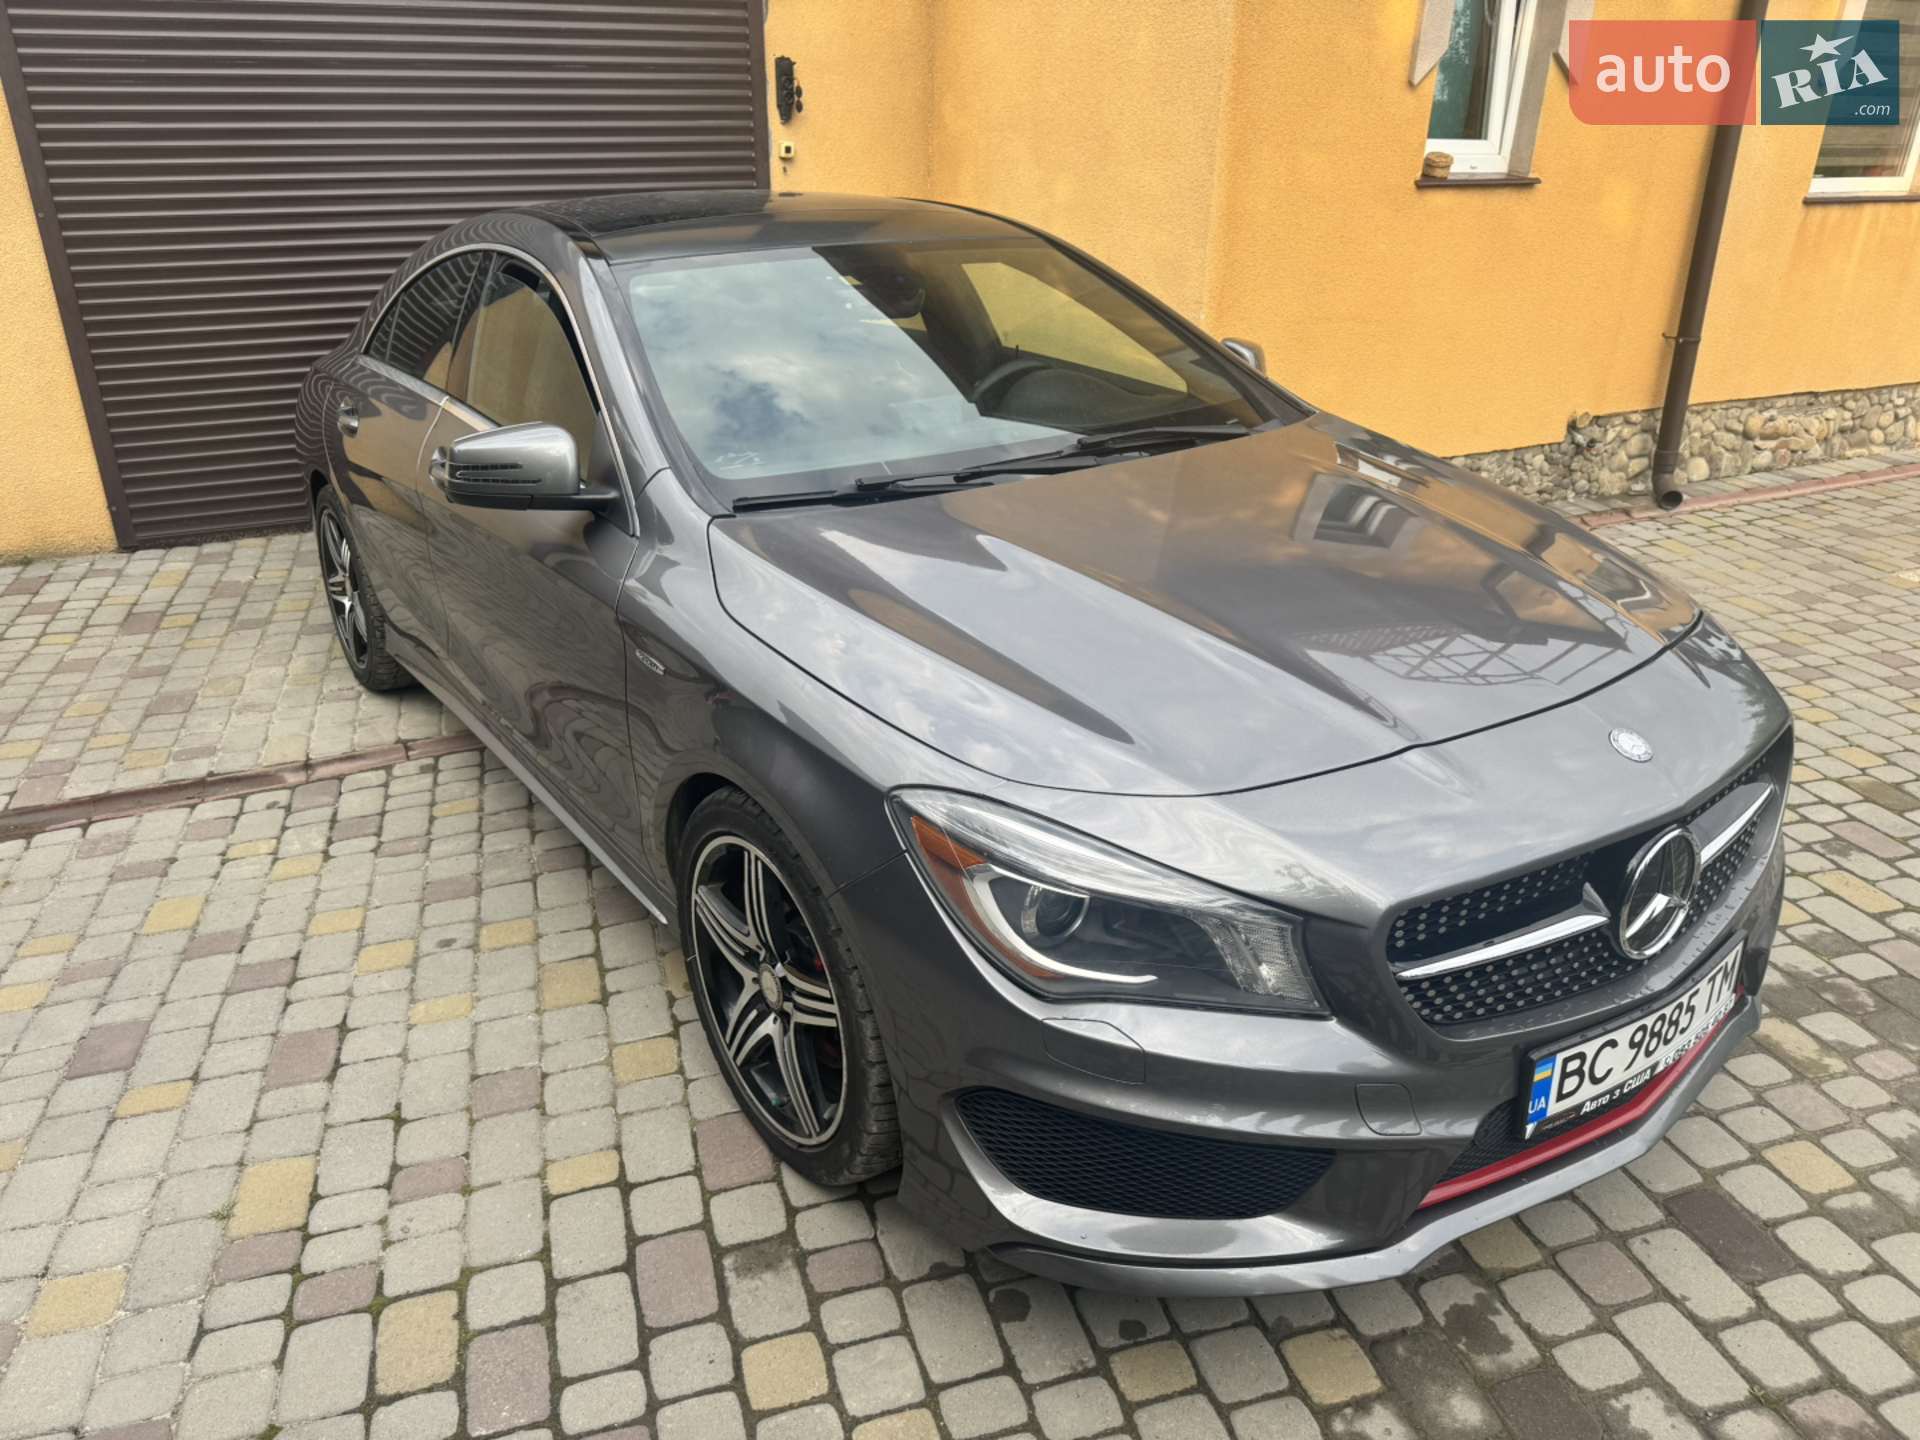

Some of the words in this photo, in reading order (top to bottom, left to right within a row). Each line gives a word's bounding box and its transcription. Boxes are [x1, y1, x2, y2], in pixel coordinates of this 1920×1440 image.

[1556, 1038, 1618, 1103] BC
[1623, 987, 1700, 1072] 9885
[1705, 949, 1740, 1014] TM
[1528, 1096, 1547, 1114] UA
